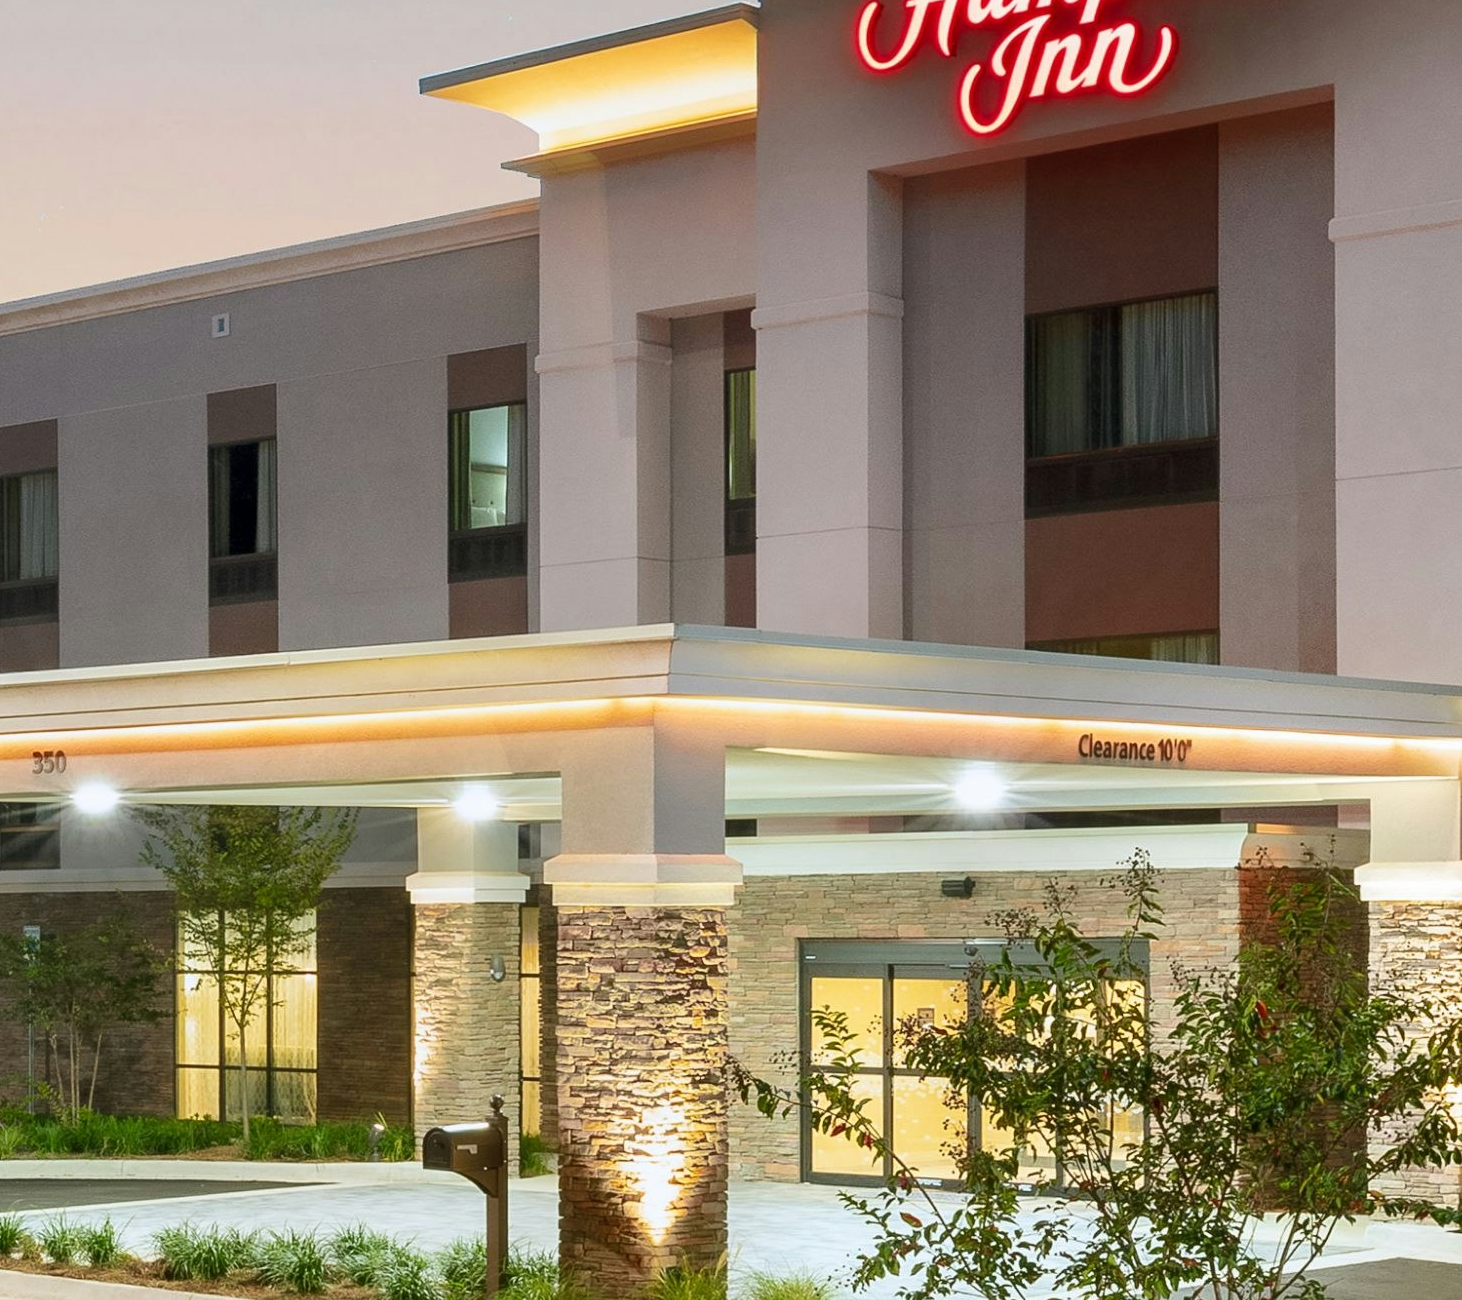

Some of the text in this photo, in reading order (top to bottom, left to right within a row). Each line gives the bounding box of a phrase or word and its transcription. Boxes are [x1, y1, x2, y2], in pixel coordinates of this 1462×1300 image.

[960, 14, 1173, 134] Inn
[1078, 733, 1155, 761] Clearance
[32, 750, 67, 775] 350
